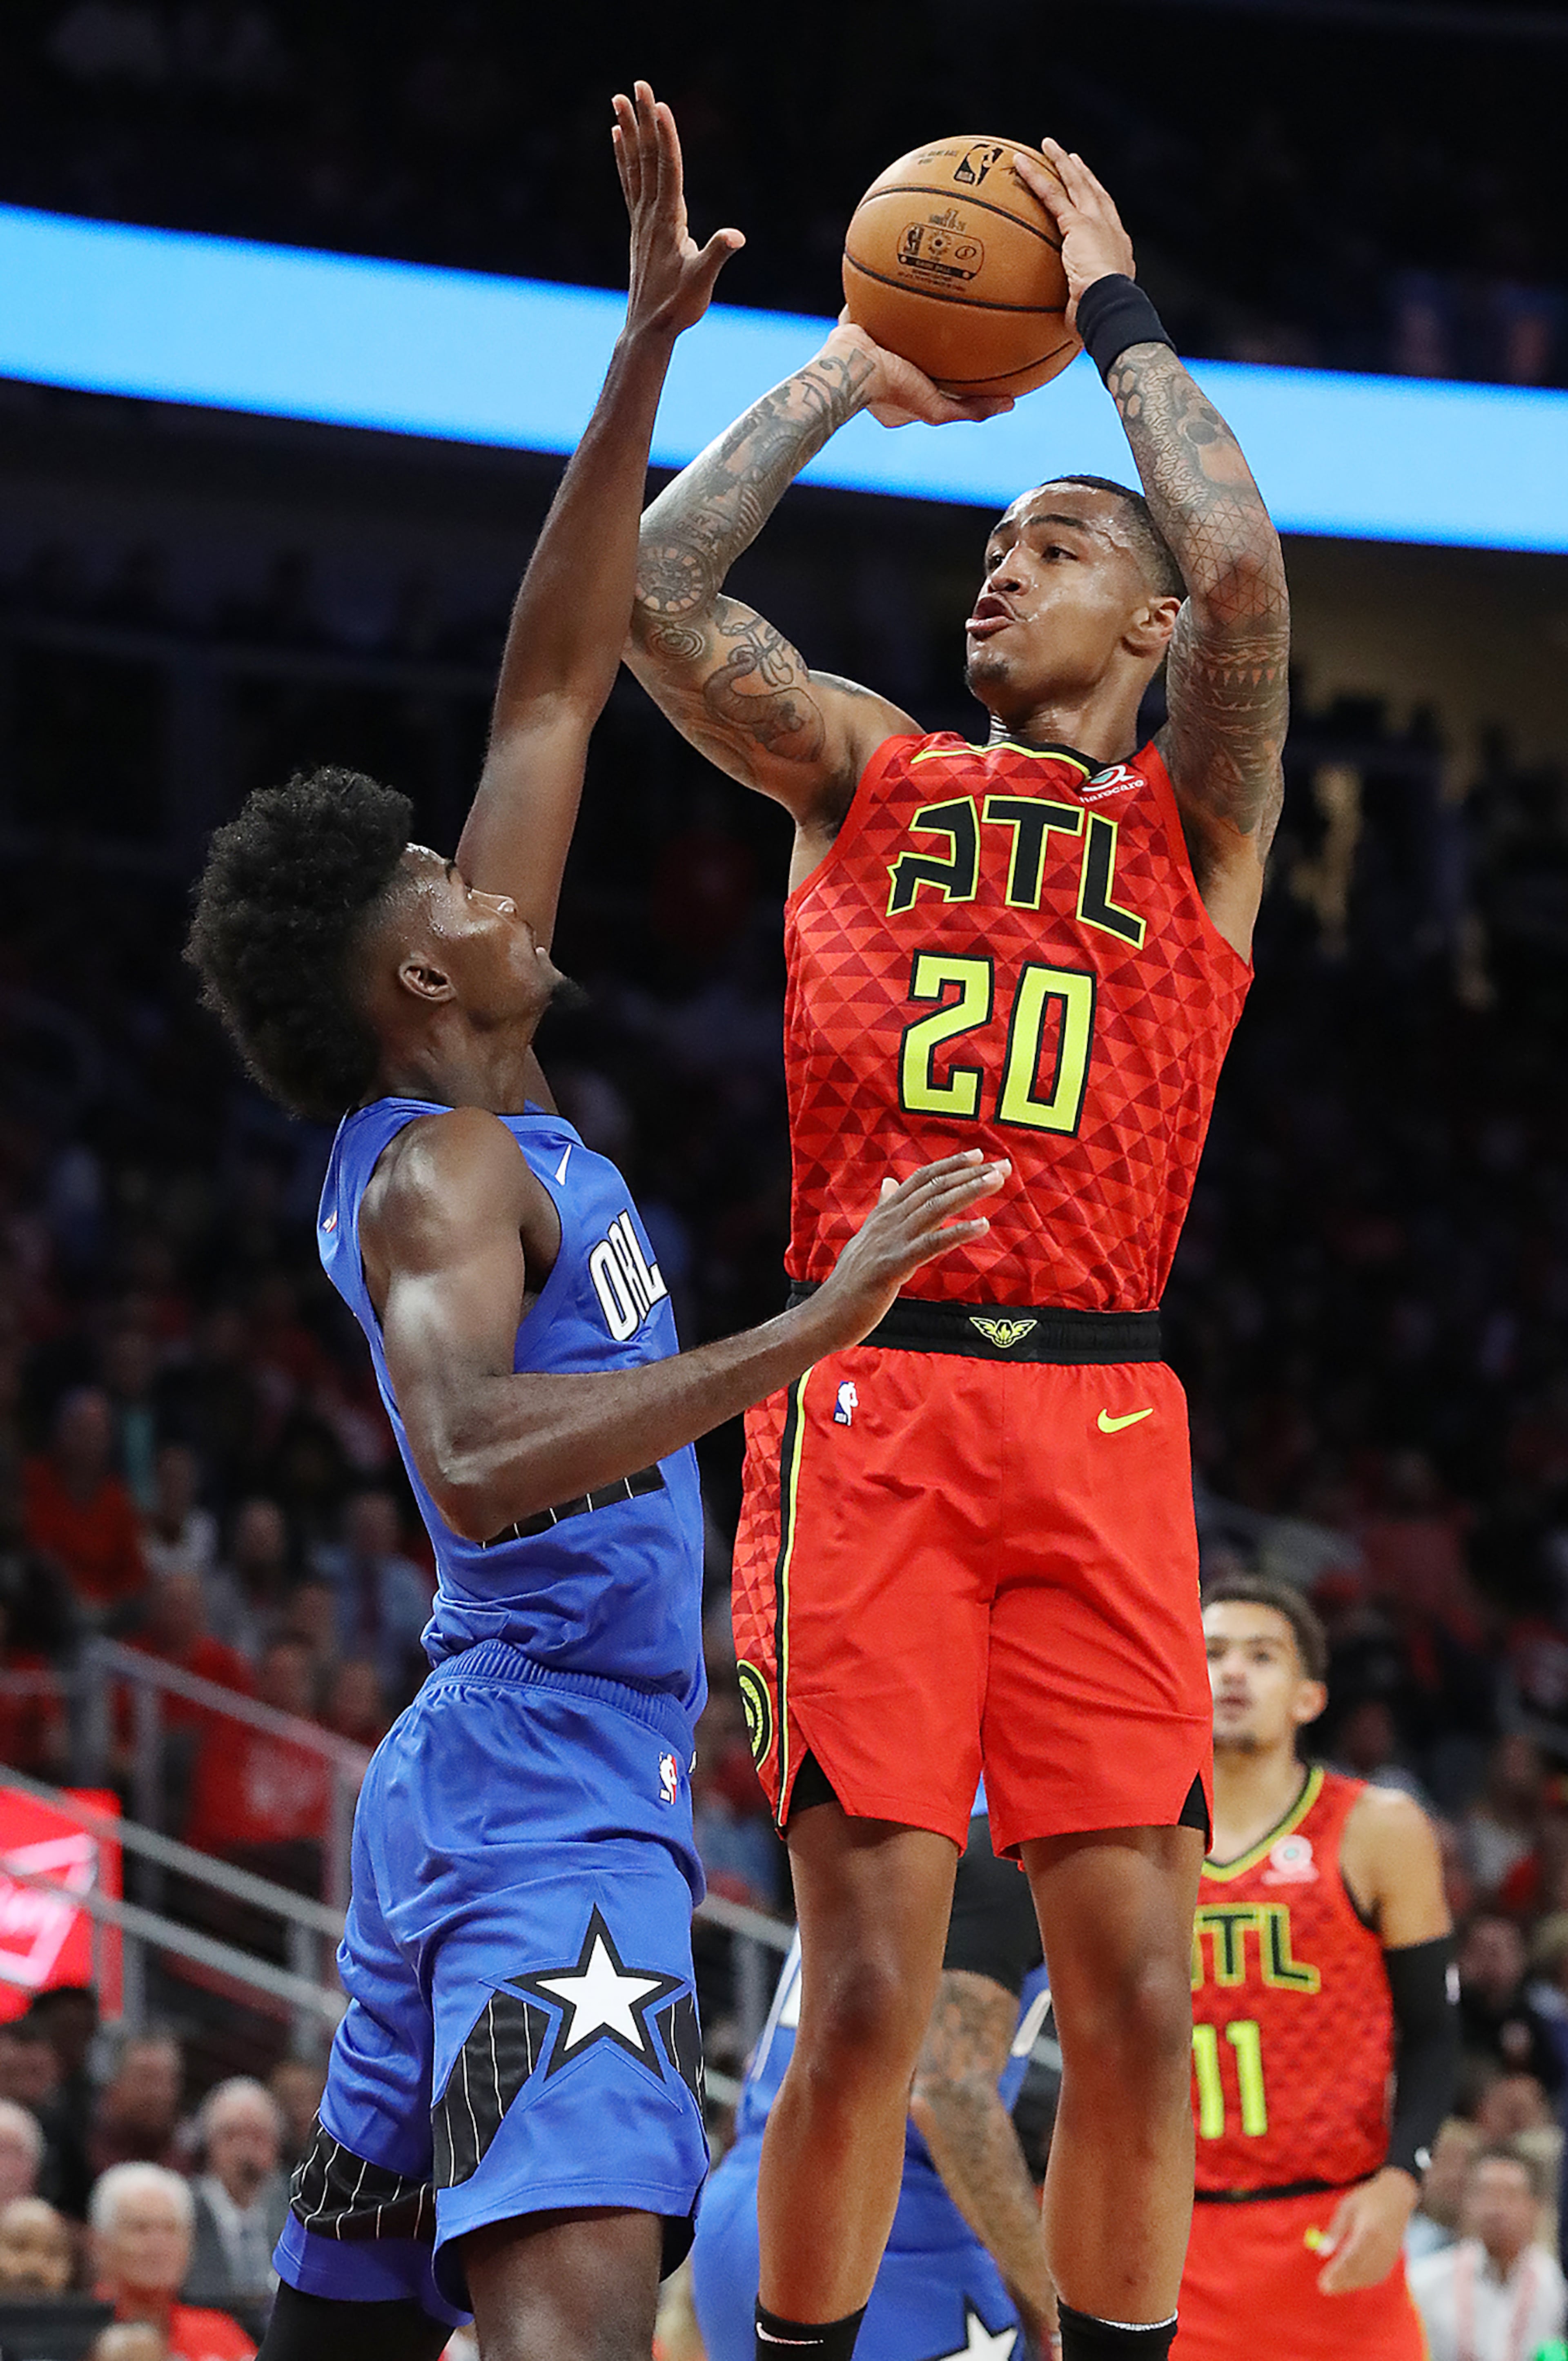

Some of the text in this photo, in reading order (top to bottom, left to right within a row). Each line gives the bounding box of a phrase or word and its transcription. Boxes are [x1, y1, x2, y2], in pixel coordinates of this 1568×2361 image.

[886, 794, 1147, 950] ATL
[899, 949, 1097, 1138] 20
[589, 1209, 670, 1342] ORL
[1191, 1902, 1321, 1995] TL
[1192, 2020, 1268, 2140] 11
